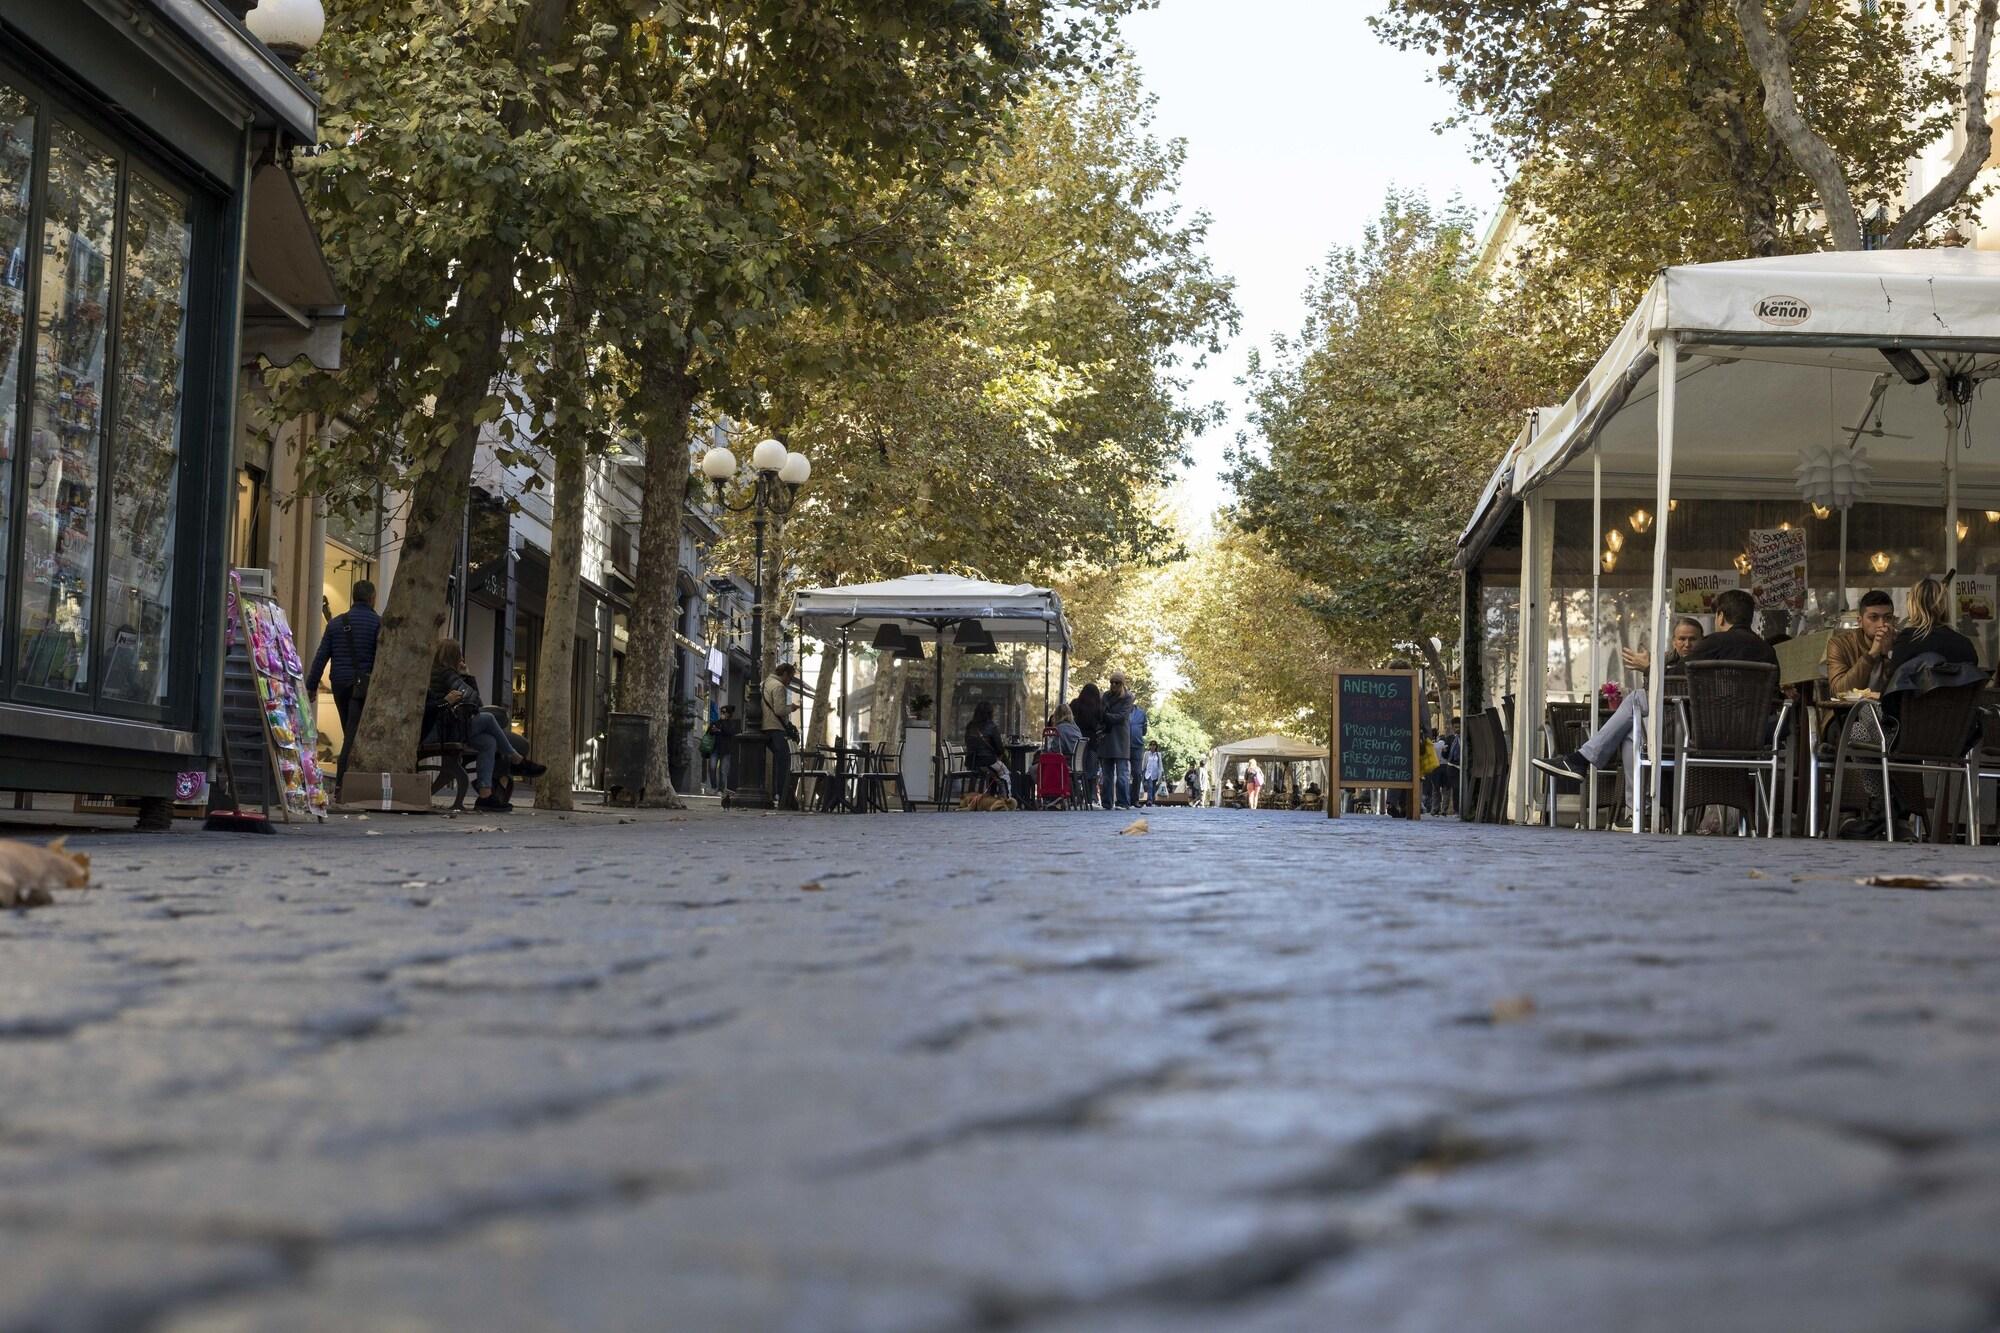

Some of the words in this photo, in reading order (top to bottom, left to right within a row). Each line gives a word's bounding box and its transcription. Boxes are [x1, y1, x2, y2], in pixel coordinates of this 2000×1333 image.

[1758, 301, 1808, 318] kenon
[1751, 541, 1780, 555] Happy
[1678, 574, 1719, 594] SANGRIA
[1343, 679, 1398, 698] ANEMOS
[1343, 723, 1376, 737] PROVA
[1351, 738, 1402, 753] APERITIVO
[1343, 752, 1379, 765] FRESCO
[1382, 755, 1408, 765] FATTO
[1344, 767, 1359, 778] AL
[1366, 768, 1411, 780] MOMENTO
